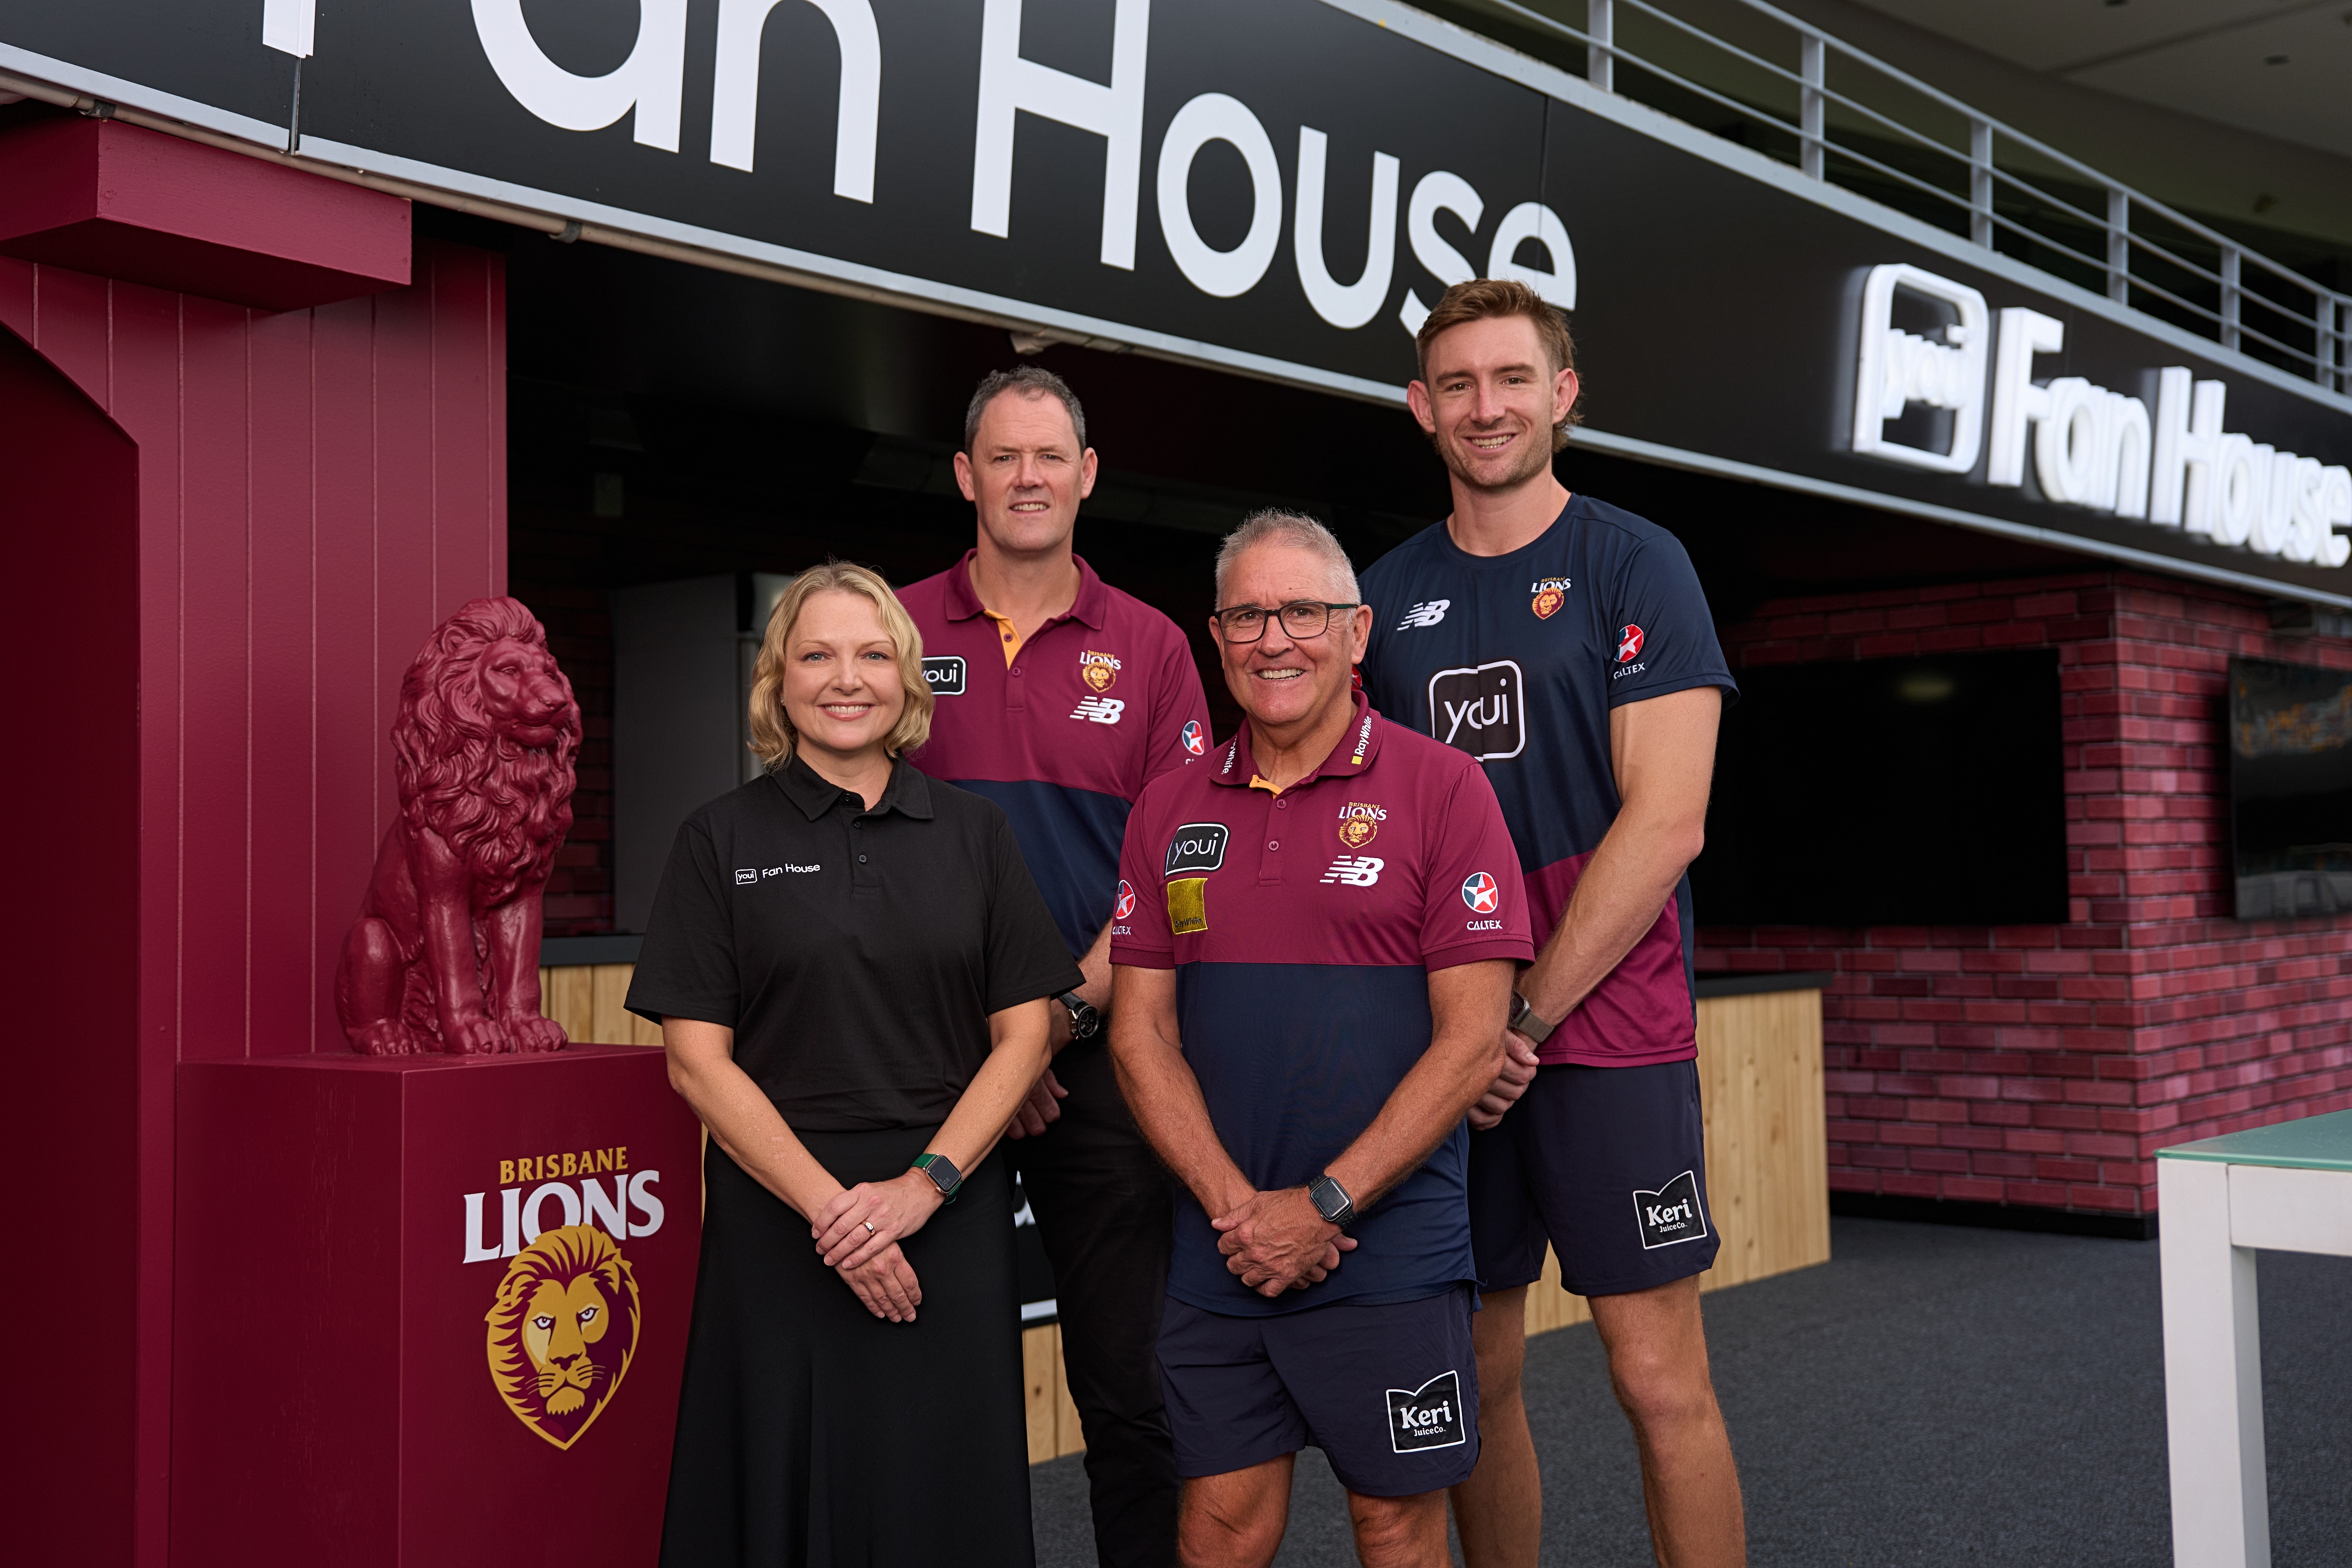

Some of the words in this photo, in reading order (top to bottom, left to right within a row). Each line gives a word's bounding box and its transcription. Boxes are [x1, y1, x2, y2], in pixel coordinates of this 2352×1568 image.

[970, 0, 1577, 340] House
[1987, 306, 2151, 519] Fan
[2150, 366, 2352, 567] House
[1531, 578, 1571, 593] LIONS
[1079, 651, 1121, 670] LIONS
[1088, 650, 1115, 658] BRISBANE
[922, 663, 958, 683] oui
[1338, 806, 1387, 820] LIONS
[1172, 833, 1219, 865] youi
[738, 871, 755, 881] youi
[762, 867, 783, 878] Fan
[785, 863, 820, 873] House
[1467, 920, 1503, 931] CALTEX
[500, 1146, 628, 1185] BRISBANE
[462, 1170, 665, 1264] LIONS
[1646, 1198, 1692, 1226] Keri
[1400, 1400, 1453, 1429] Keri
